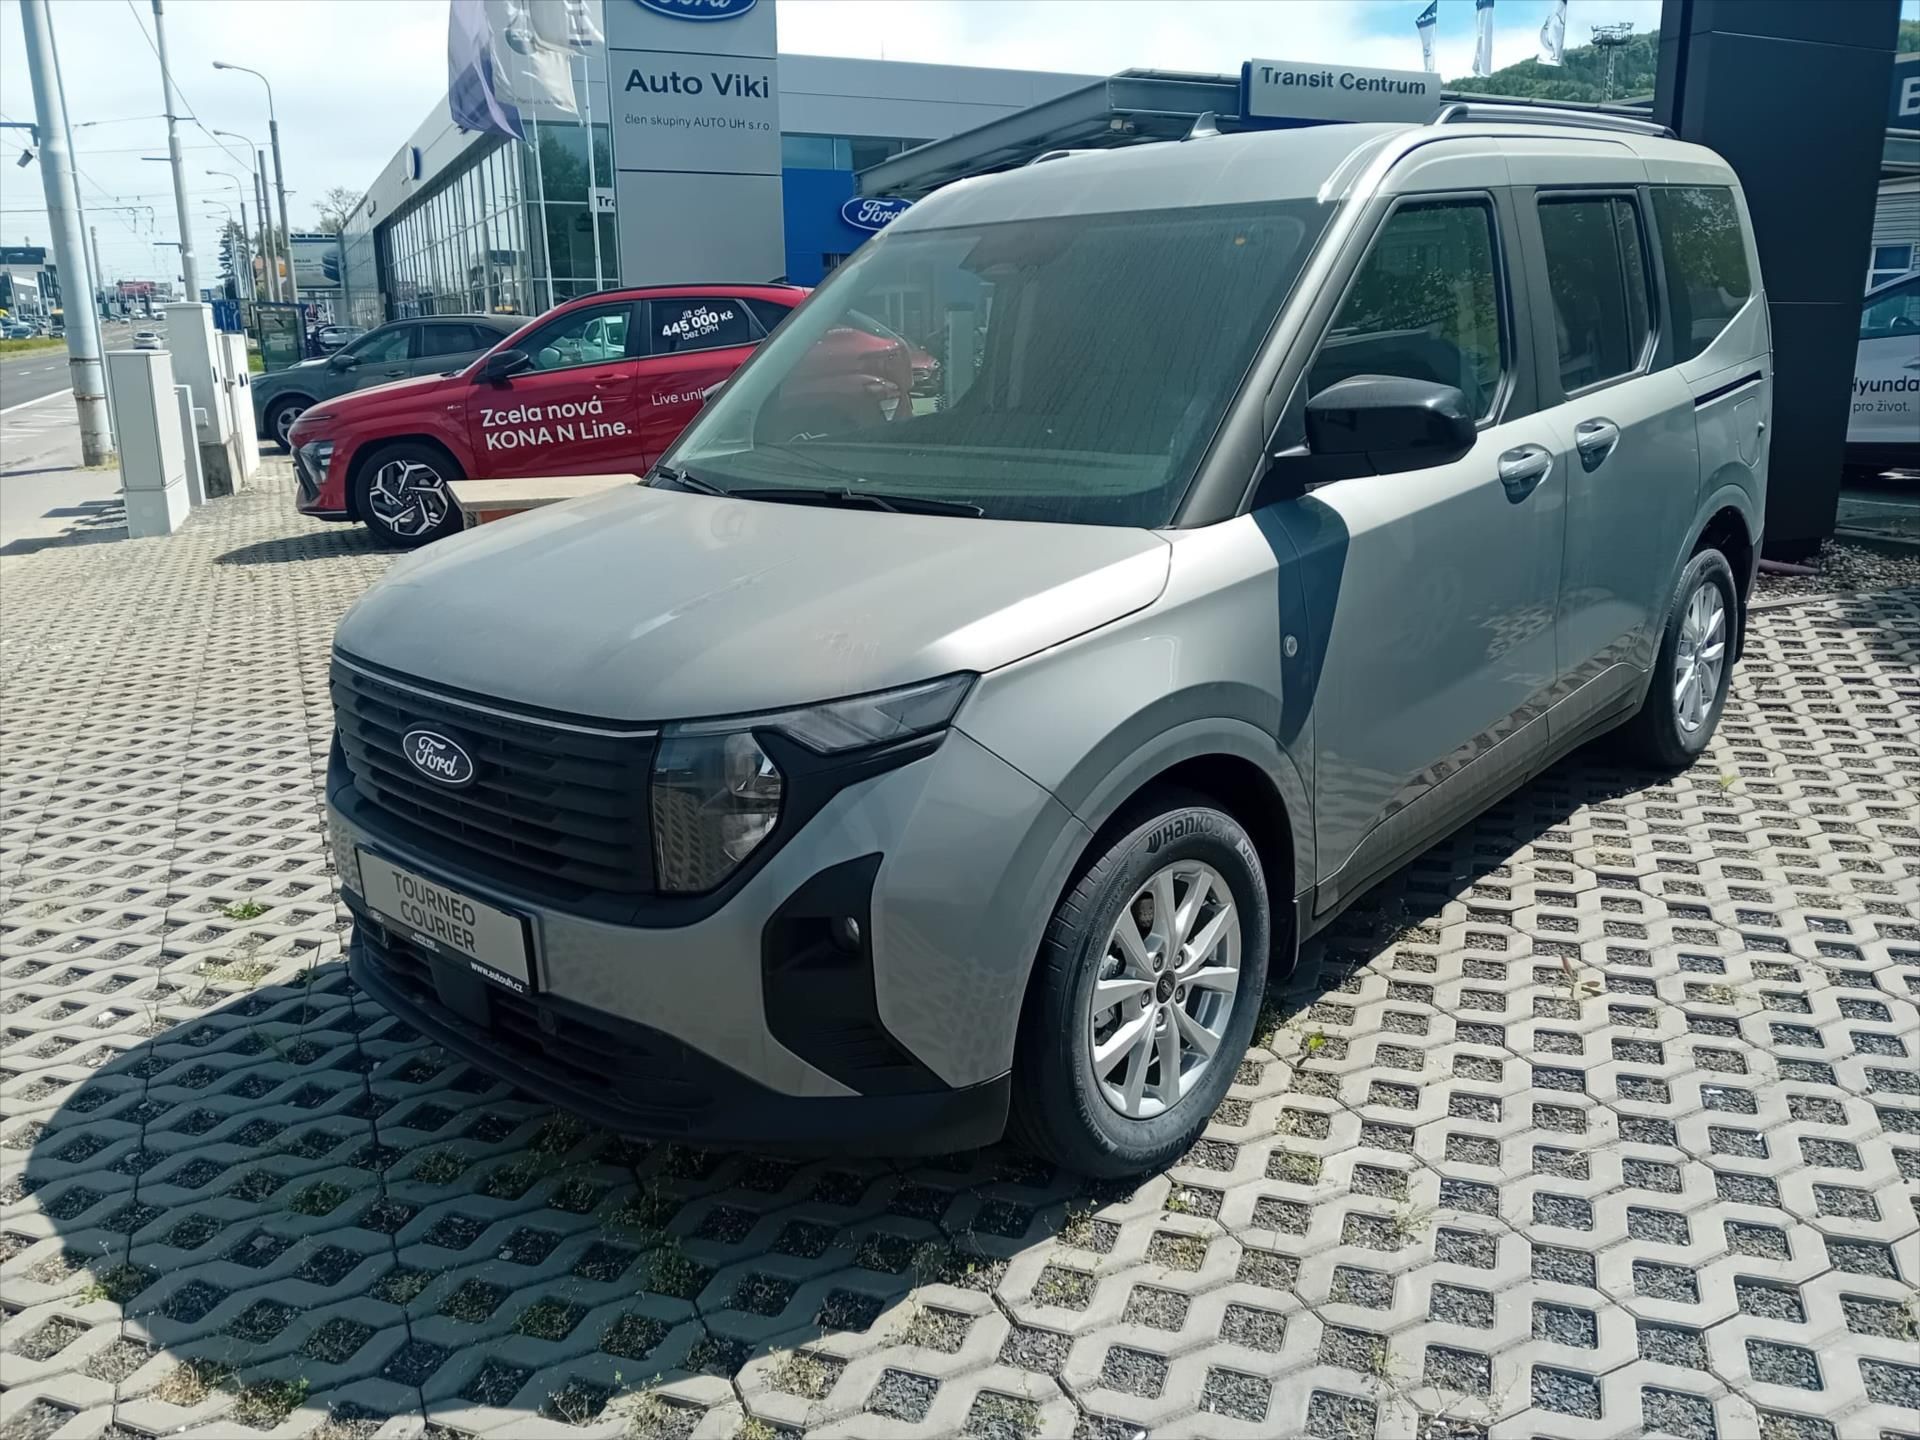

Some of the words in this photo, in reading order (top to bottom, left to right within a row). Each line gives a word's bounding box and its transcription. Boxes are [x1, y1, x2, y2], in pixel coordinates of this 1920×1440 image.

[625, 68, 703, 95] Auto
[711, 72, 769, 98] Viki
[1261, 66, 1334, 88] Transit
[1340, 72, 1426, 95] Centrum
[625, 113, 647, 125] člen
[651, 115, 691, 128] skupiny
[693, 117, 726, 128] AUTO
[729, 118, 745, 129] UH
[662, 320, 690, 336] 445
[691, 312, 719, 329] 000
[694, 305, 707, 316] od
[682, 330, 699, 340] bez
[700, 324, 719, 335] DPH
[480, 404, 542, 427] Zcela
[547, 395, 603, 419] nová
[651, 393, 679, 406] Live
[1853, 403, 1874, 415] pro
[1877, 400, 1911, 412] život.
[486, 427, 554, 450] KONA
[556, 425, 575, 442] N
[579, 420, 632, 439] Line.
[415, 736, 458, 776] Ford
[391, 871, 476, 927] TOURNEO
[400, 900, 476, 953] COURIER
